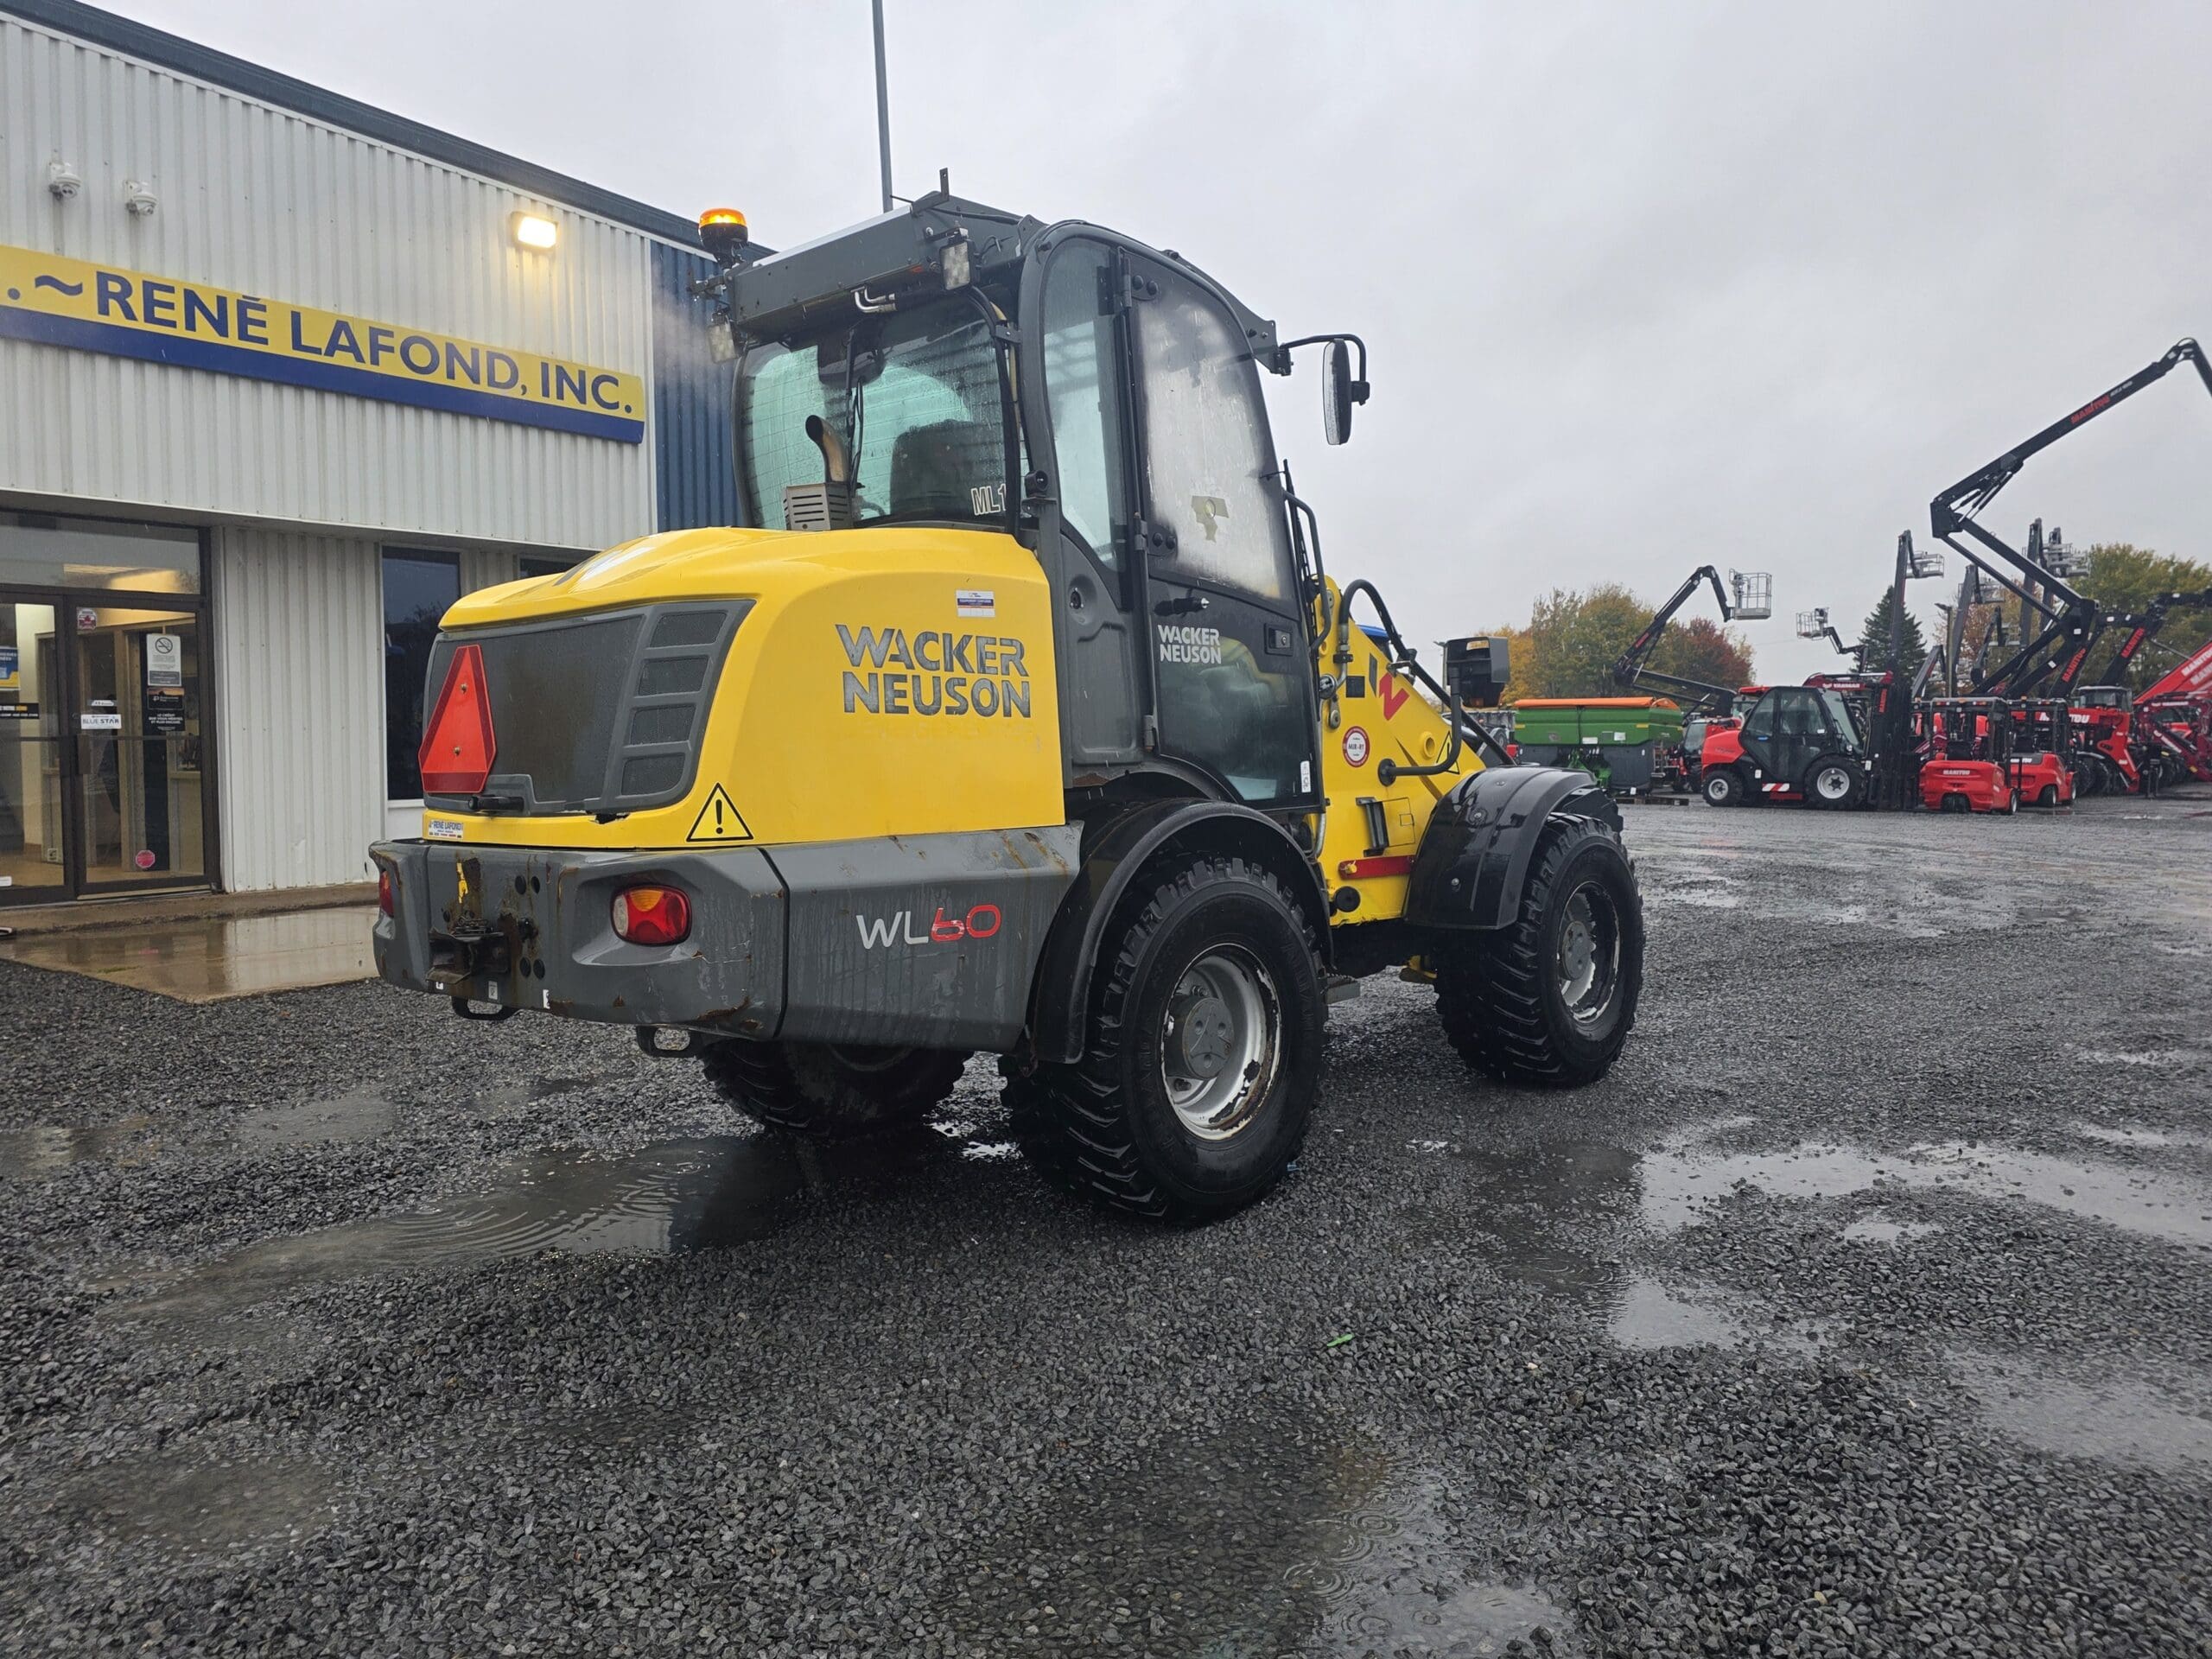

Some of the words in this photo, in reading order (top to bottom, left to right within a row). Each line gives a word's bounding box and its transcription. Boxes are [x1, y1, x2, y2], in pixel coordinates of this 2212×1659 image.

[290, 310, 528, 396] LAFOND,
[541, 362, 632, 413] INC.
[836, 624, 1030, 677] WACKER
[1158, 625, 1221, 646] WACKER
[1160, 644, 1222, 664] NEUSON
[842, 671, 1032, 718] NEUSON
[855, 904, 1002, 950] WL60
